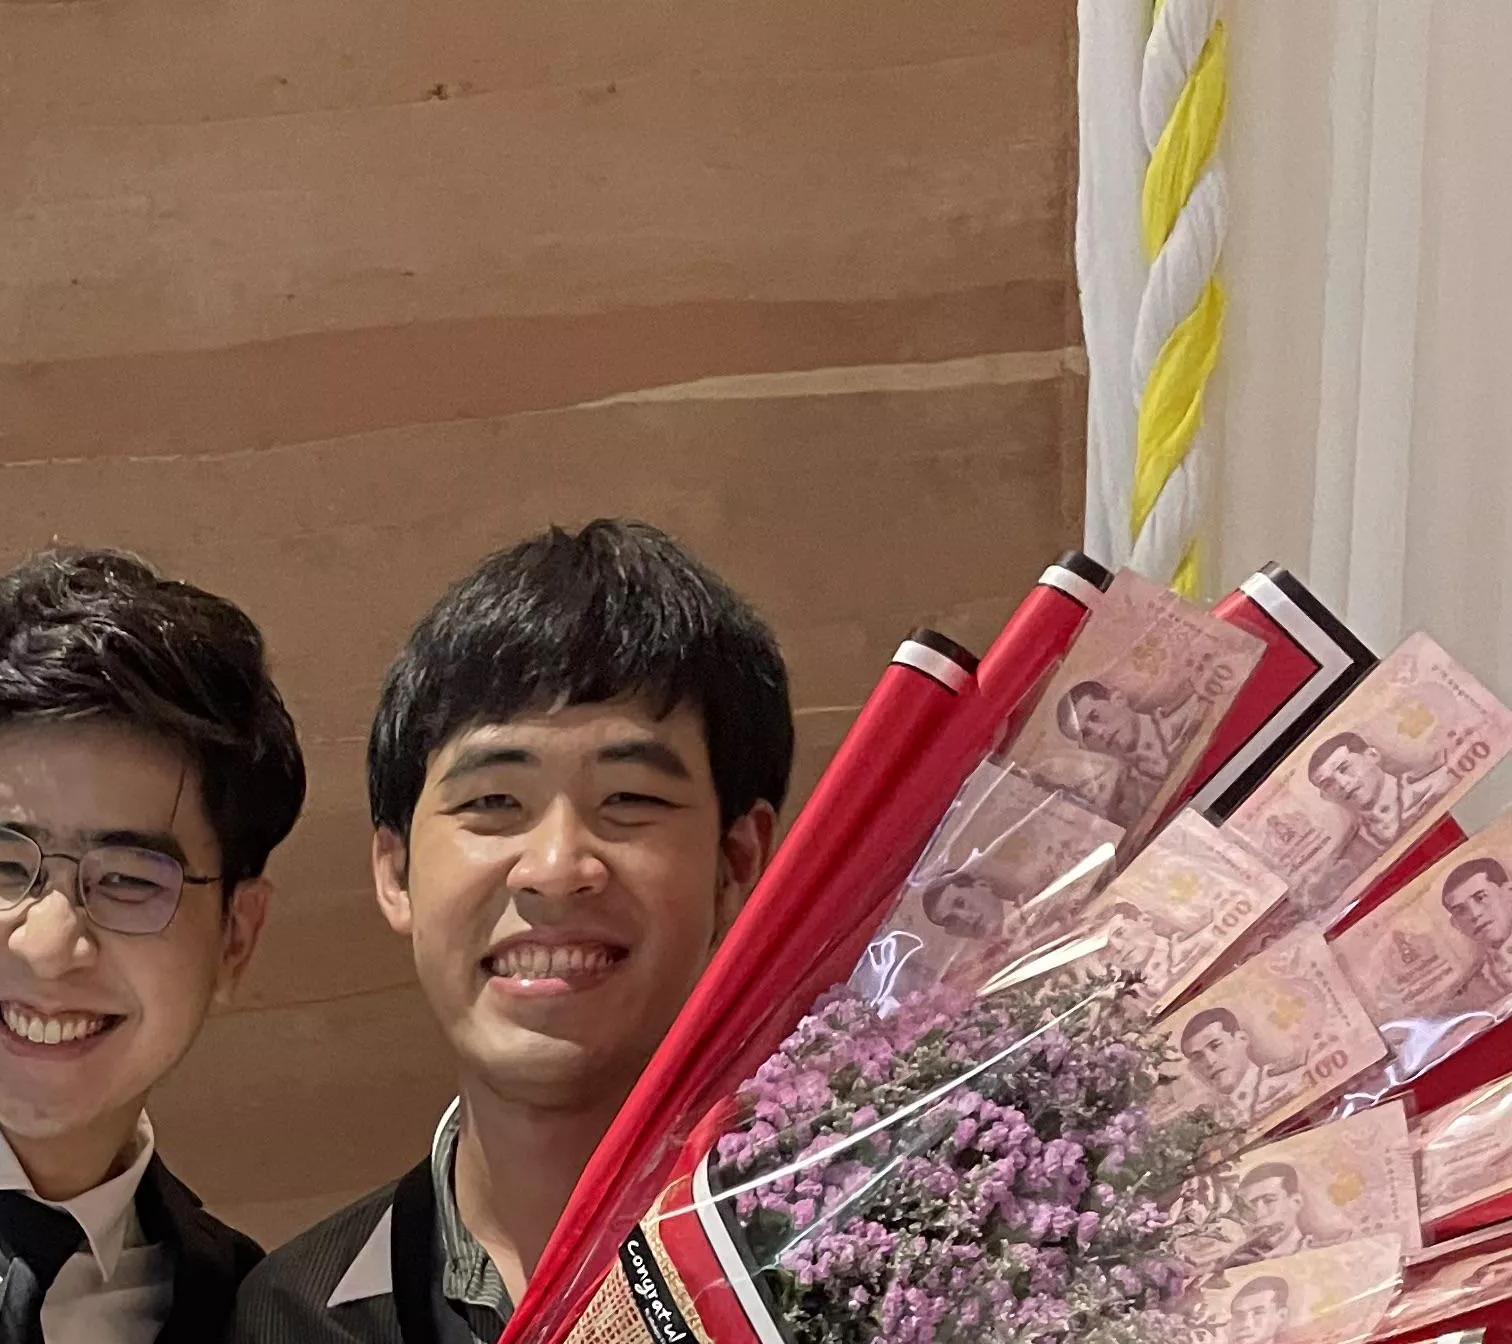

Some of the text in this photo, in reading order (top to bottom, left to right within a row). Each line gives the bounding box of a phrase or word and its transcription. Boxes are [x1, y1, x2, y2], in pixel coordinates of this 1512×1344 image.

[1198, 664, 1234, 706] 100
[1447, 741, 1490, 780] 100
[1212, 899, 1253, 937] 100
[1302, 1050, 1349, 1087] 100
